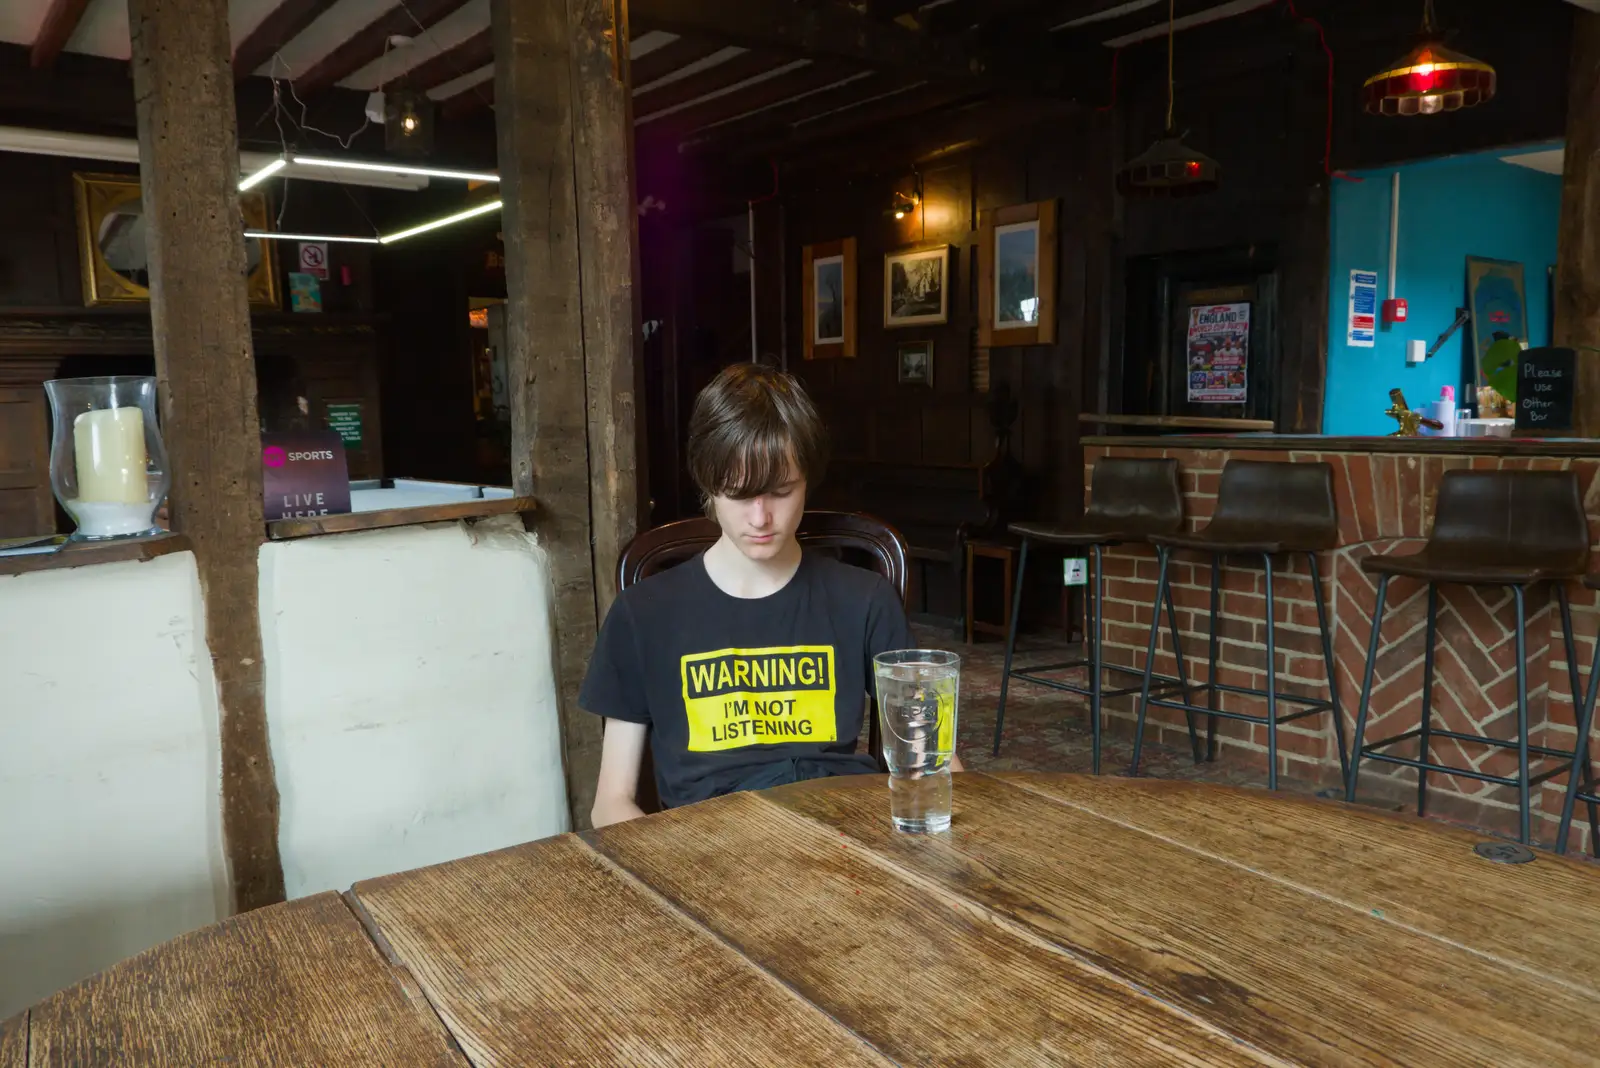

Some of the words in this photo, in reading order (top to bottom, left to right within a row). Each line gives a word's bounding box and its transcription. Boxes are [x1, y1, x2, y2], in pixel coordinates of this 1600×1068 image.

[1199, 312, 1236, 324] ENGLAND
[1524, 363, 1562, 378] Please
[1530, 410, 1548, 421] Bar
[288, 450, 333, 461] SPORTS
[283, 493, 324, 508] LIVE
[690, 657, 824, 693] WARNING!
[724, 700, 749, 718] I'M
[755, 699, 796, 716] NOT
[712, 719, 812, 742] LISTENING
